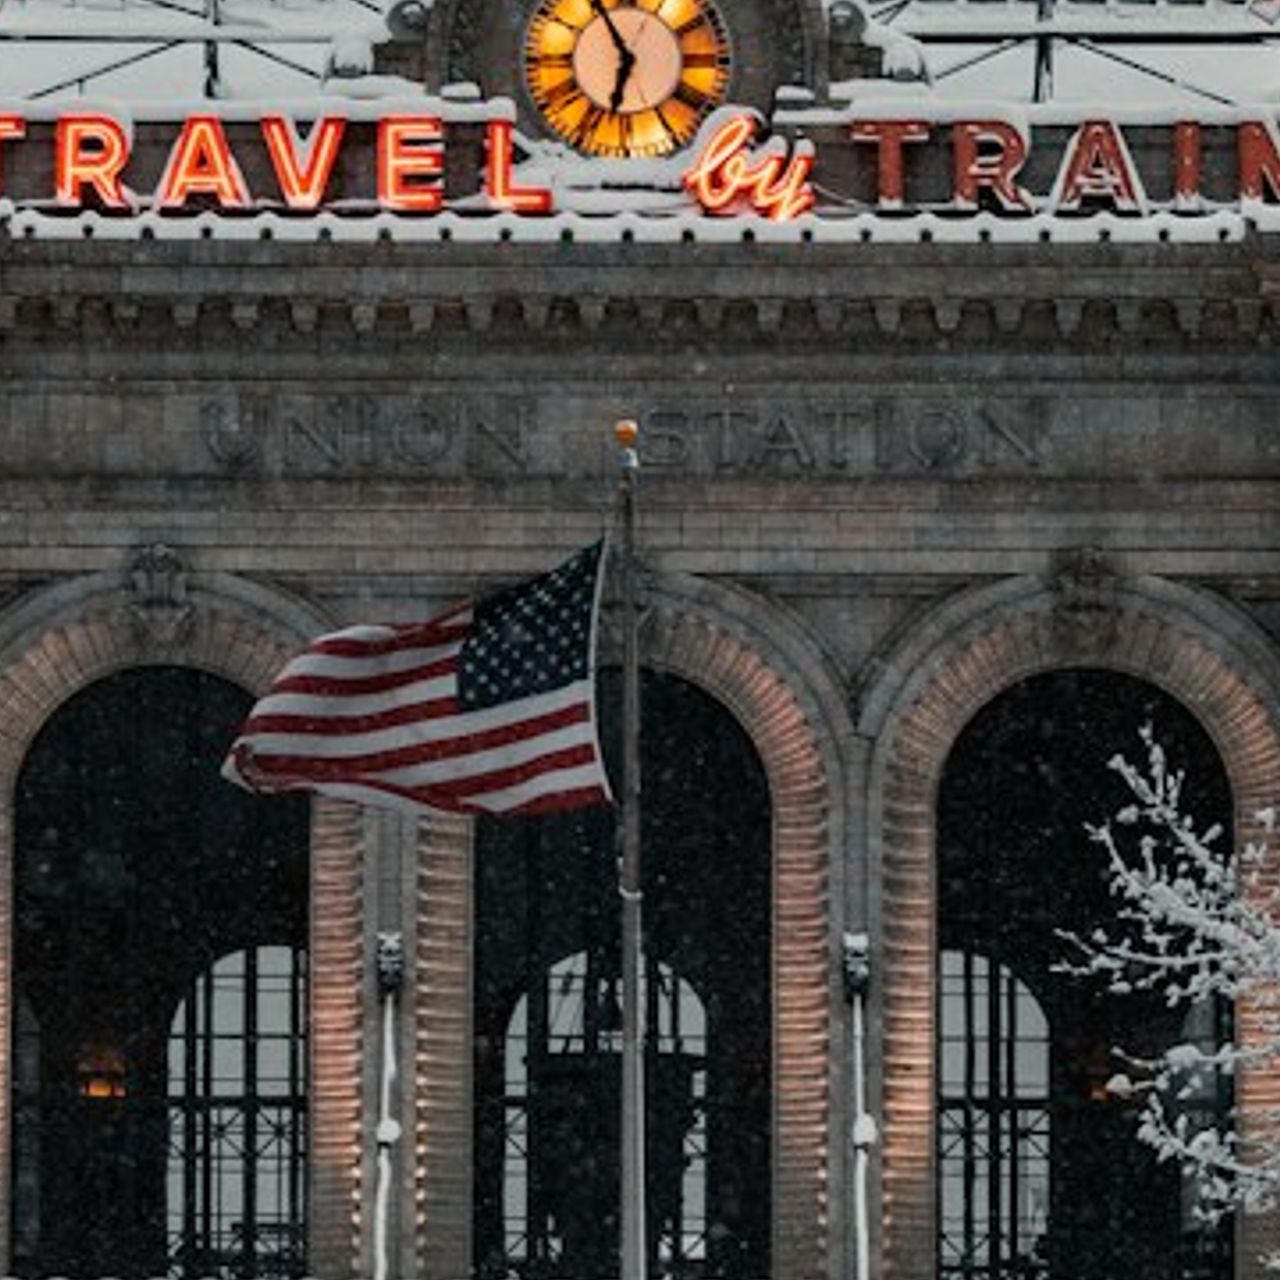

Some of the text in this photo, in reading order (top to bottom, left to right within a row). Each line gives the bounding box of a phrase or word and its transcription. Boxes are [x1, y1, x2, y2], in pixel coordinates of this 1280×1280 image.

[683, 113, 816, 221] by
[200, 394, 1044, 467] UNION STATION
